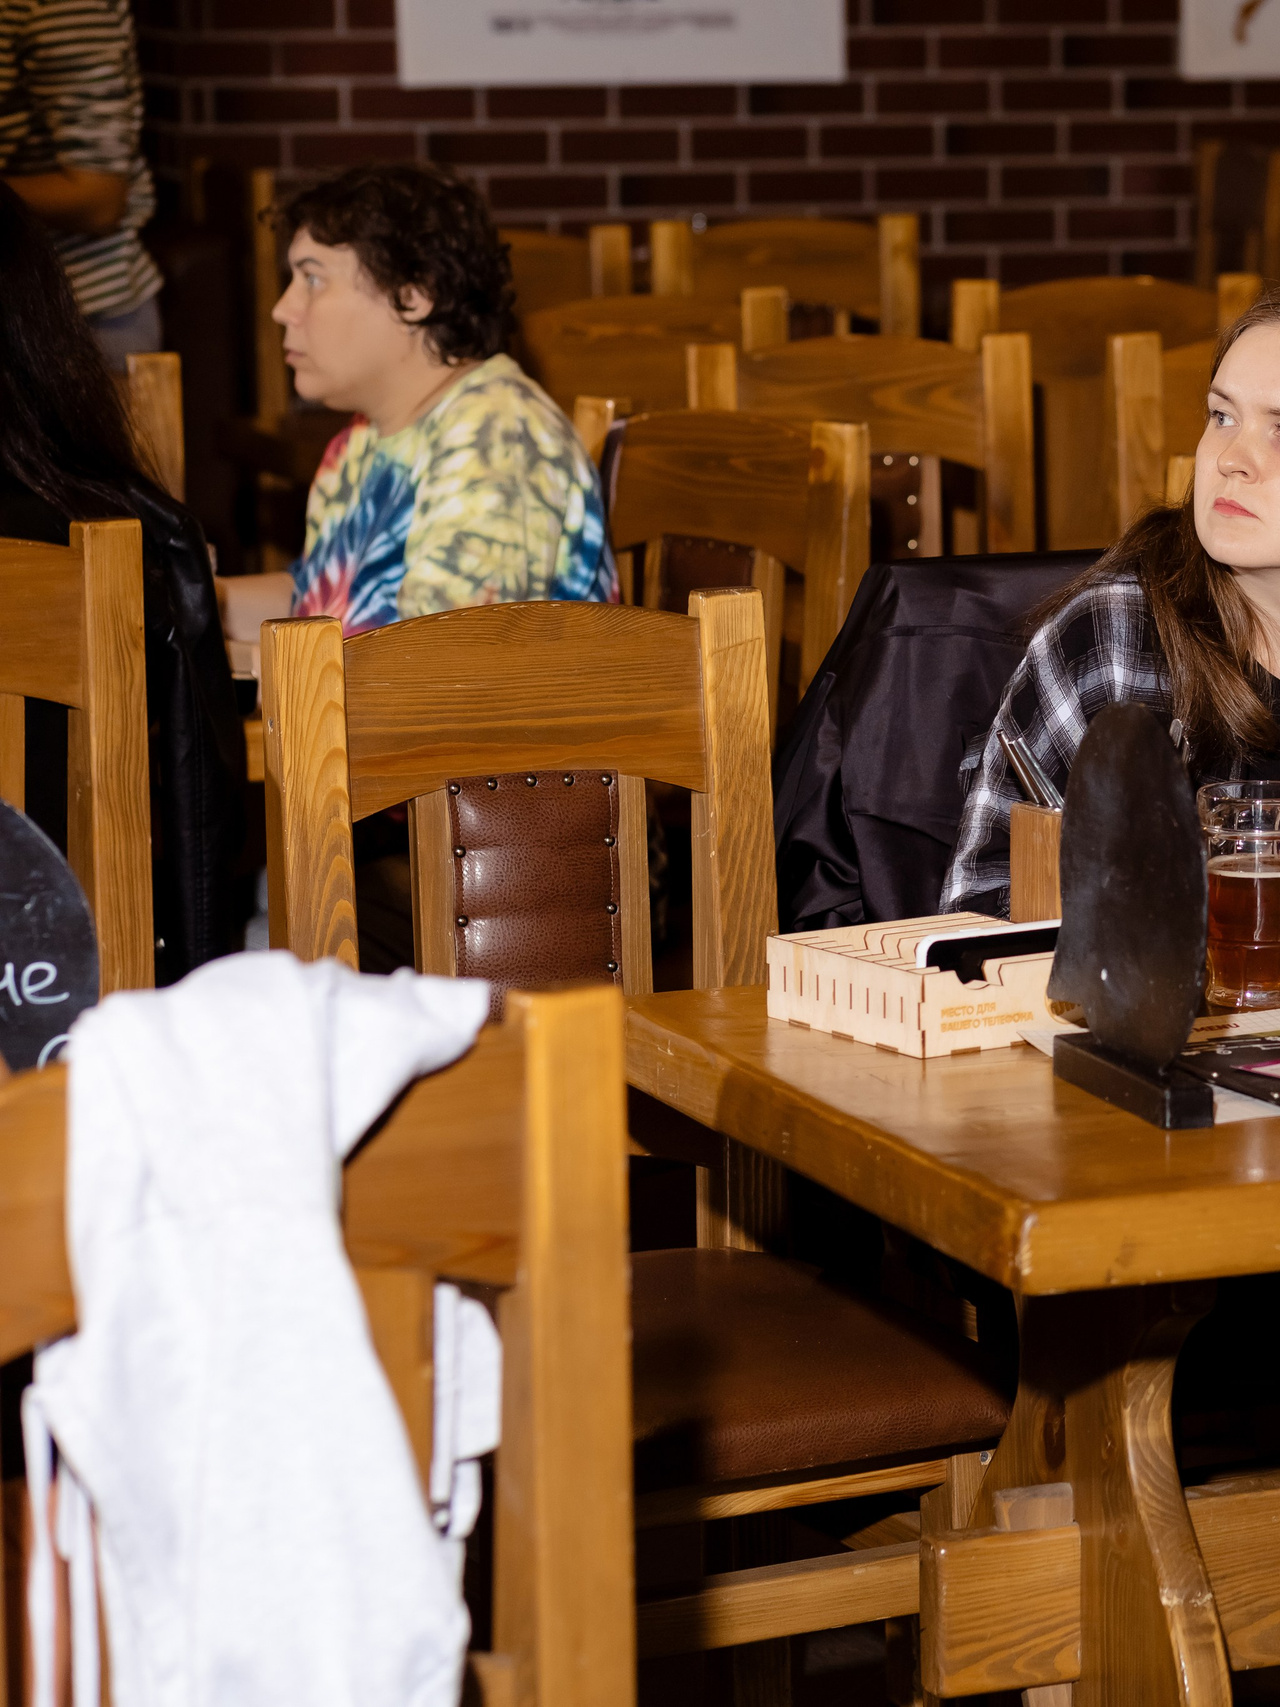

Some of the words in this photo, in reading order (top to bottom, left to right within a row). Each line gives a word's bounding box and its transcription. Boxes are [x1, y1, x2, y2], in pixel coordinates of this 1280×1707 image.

[941, 1005, 975, 1019] МЕСТО
[976, 1002, 997, 1016] ДЛЯ
[941, 1018, 981, 1033] ВАШЕГО
[982, 1011, 1034, 1028] ТЕЛЕФОНА
